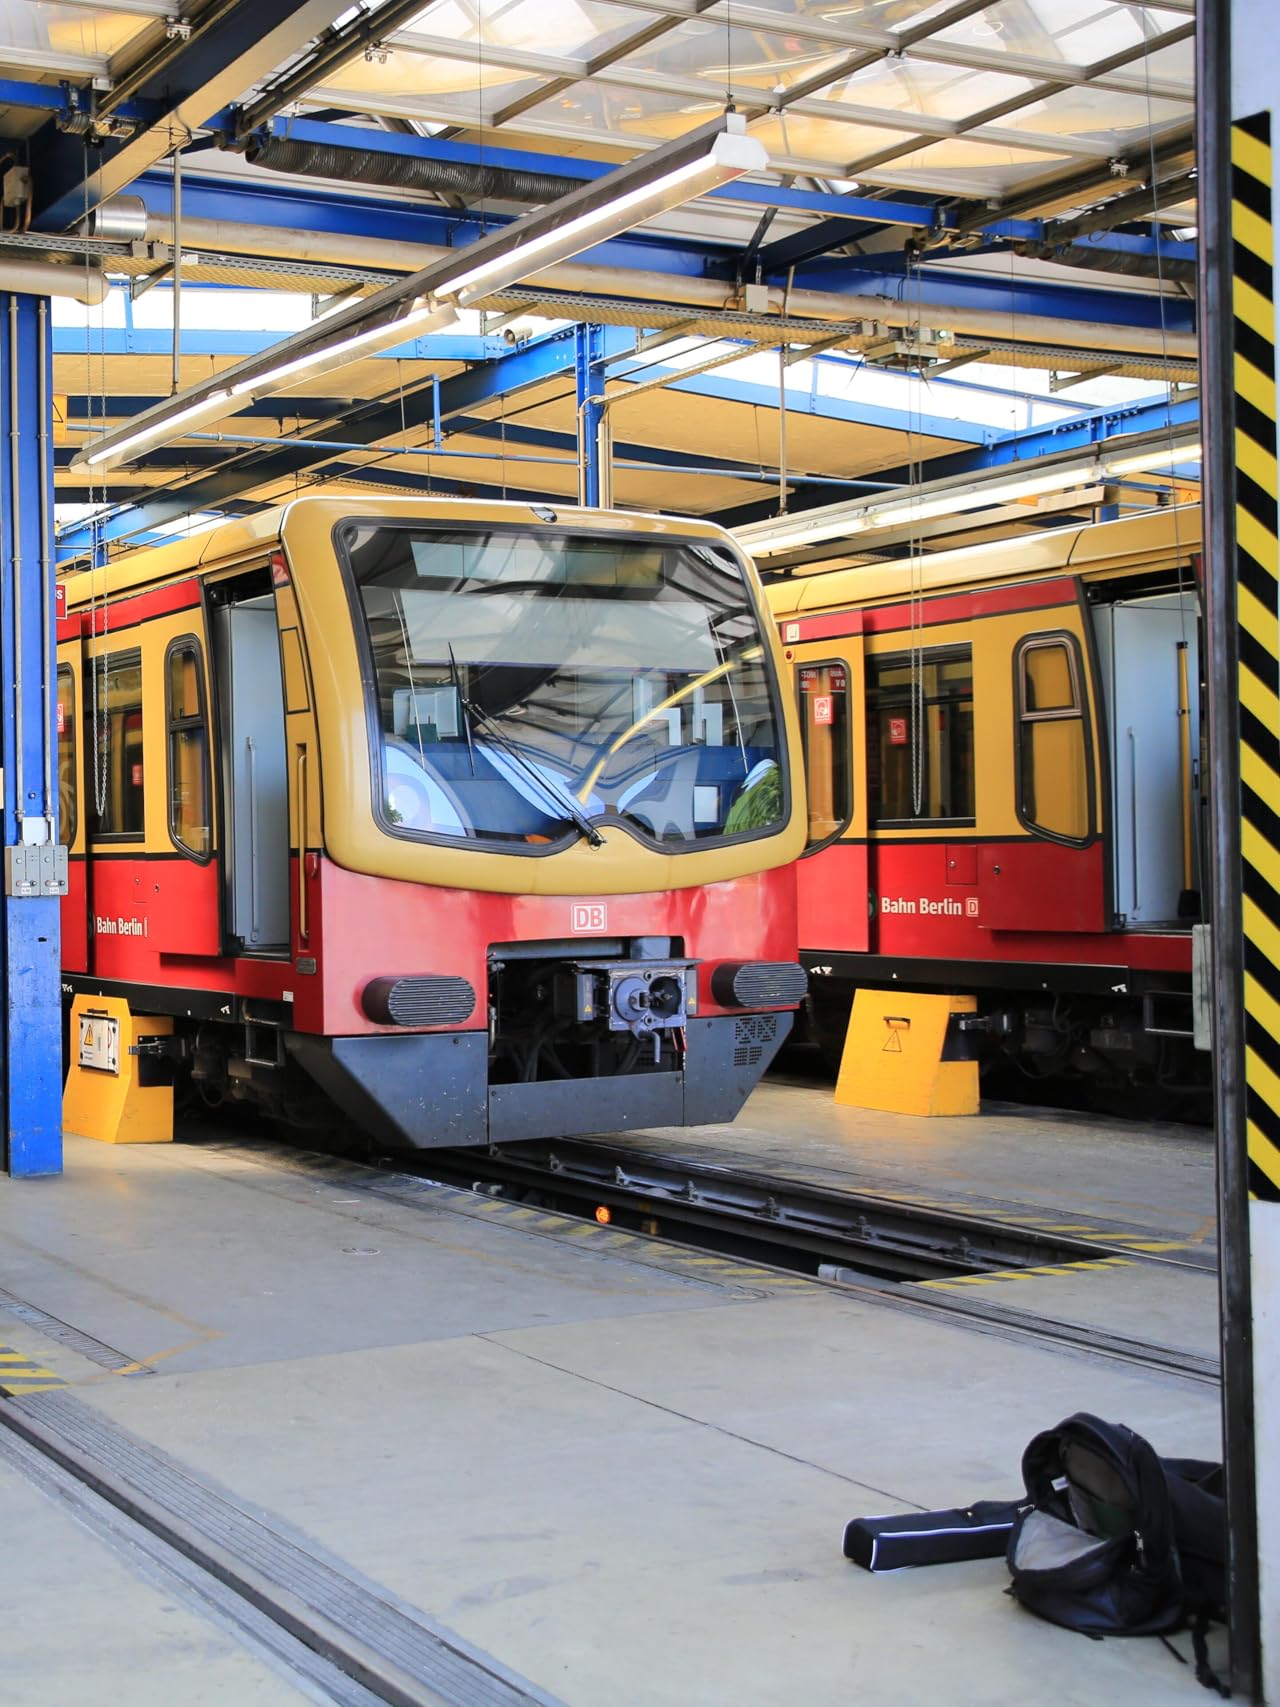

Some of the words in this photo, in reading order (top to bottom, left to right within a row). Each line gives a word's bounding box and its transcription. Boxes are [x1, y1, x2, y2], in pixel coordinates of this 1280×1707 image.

[881, 897, 916, 914] Bahn
[919, 897, 962, 915] Berlin
[96, 916, 117, 934] Bahn
[118, 917, 143, 936] Berlin
[574, 905, 604, 930] DB
